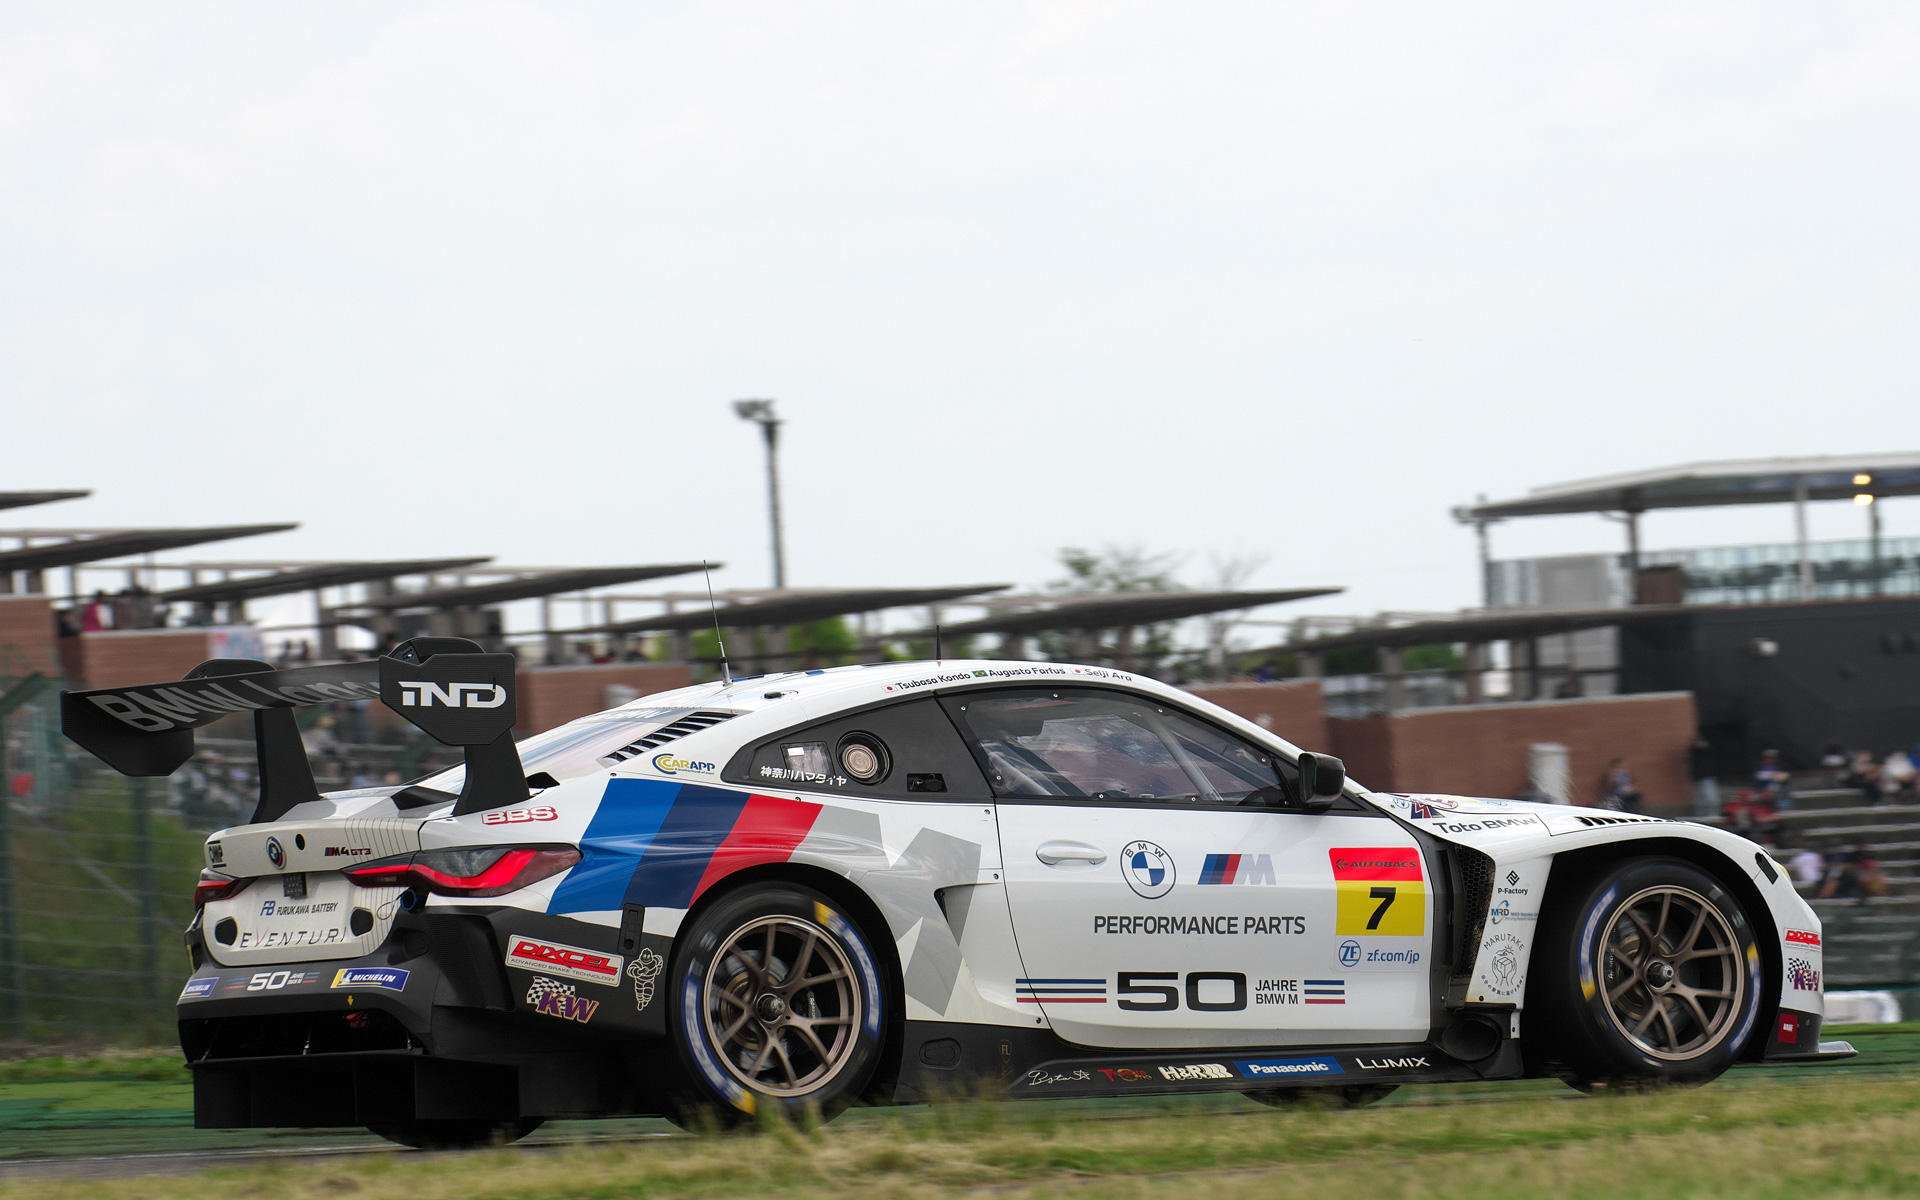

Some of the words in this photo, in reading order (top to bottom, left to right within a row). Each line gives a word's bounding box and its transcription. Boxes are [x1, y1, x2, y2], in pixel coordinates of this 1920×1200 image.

[988, 668, 1031, 678] Augusto
[1033, 667, 1066, 675] Farfus
[1085, 669, 1109, 678] Seiji
[1112, 673, 1132, 681] Ara
[897, 678, 938, 690] Tsubasa
[939, 673, 971, 683] Kondo
[86, 679, 275, 732] BMW
[760, 765, 847, 787] 神奈川ハマタイヤ
[481, 806, 559, 825] BBS
[1432, 822, 1482, 834] Toto
[1481, 818, 1538, 829] BMW
[350, 848, 372, 856] GT3
[1124, 842, 1165, 859] BMW
[1350, 860, 1417, 868] AUTOBACS
[1497, 887, 1528, 895] P-Factory
[276, 905, 310, 916] FURUKAWA
[311, 902, 339, 913] BATTERY
[1365, 886, 1397, 931] 7
[1490, 908, 1510, 917] MRD
[1093, 915, 1238, 935] PERFORMANCE
[1243, 916, 1306, 935] PARTS
[240, 926, 347, 948] EVENTURI
[1483, 933, 1525, 951] MARUTAKE
[511, 941, 618, 975] DIXCEL
[1340, 946, 1360, 961] ZF
[1366, 949, 1421, 965] zf.com/jp
[351, 973, 397, 983] MICHELIN
[510, 958, 547, 969] ADVANCED
[548, 965, 571, 974] BRAKE
[572, 970, 617, 983] TECHNOLOGY
[247, 971, 292, 991] 50
[1255, 980, 1298, 992] JAHRE
[1117, 971, 1248, 1012] 50
[1256, 994, 1286, 1005] BMW
[1288, 994, 1299, 1005] M
[536, 991, 600, 1024] KW
[1248, 1062, 1330, 1075] Panasonic
[1355, 1056, 1431, 1069] LUMIX
